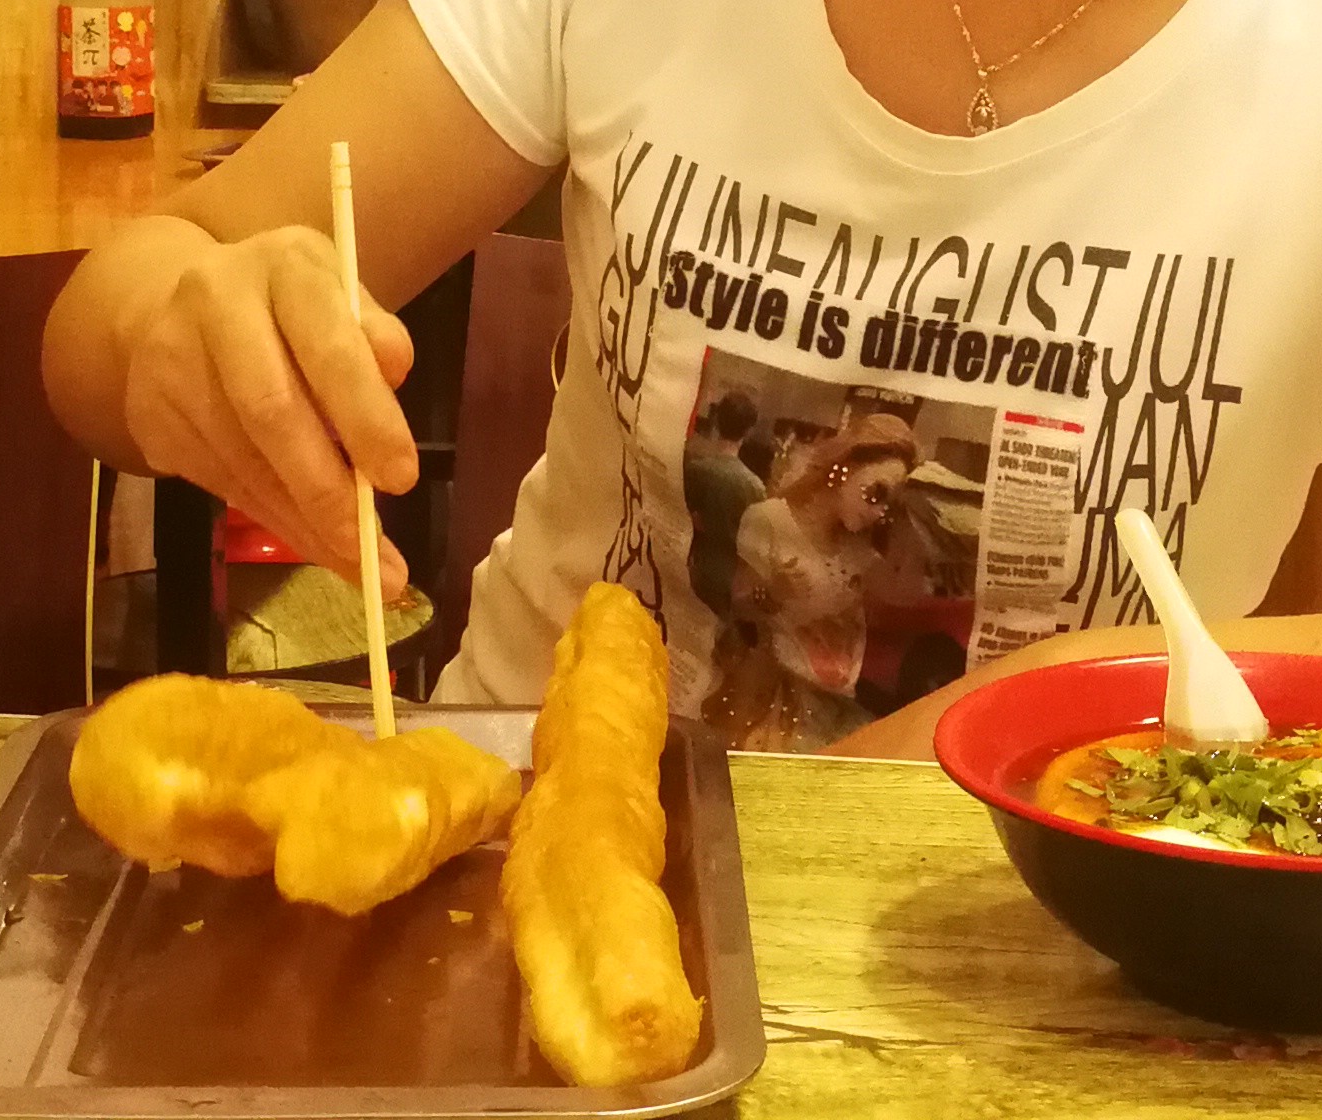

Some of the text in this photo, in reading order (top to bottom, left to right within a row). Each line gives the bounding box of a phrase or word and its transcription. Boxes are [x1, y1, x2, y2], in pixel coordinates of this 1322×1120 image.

[664, 250, 1098, 399] Style is different
